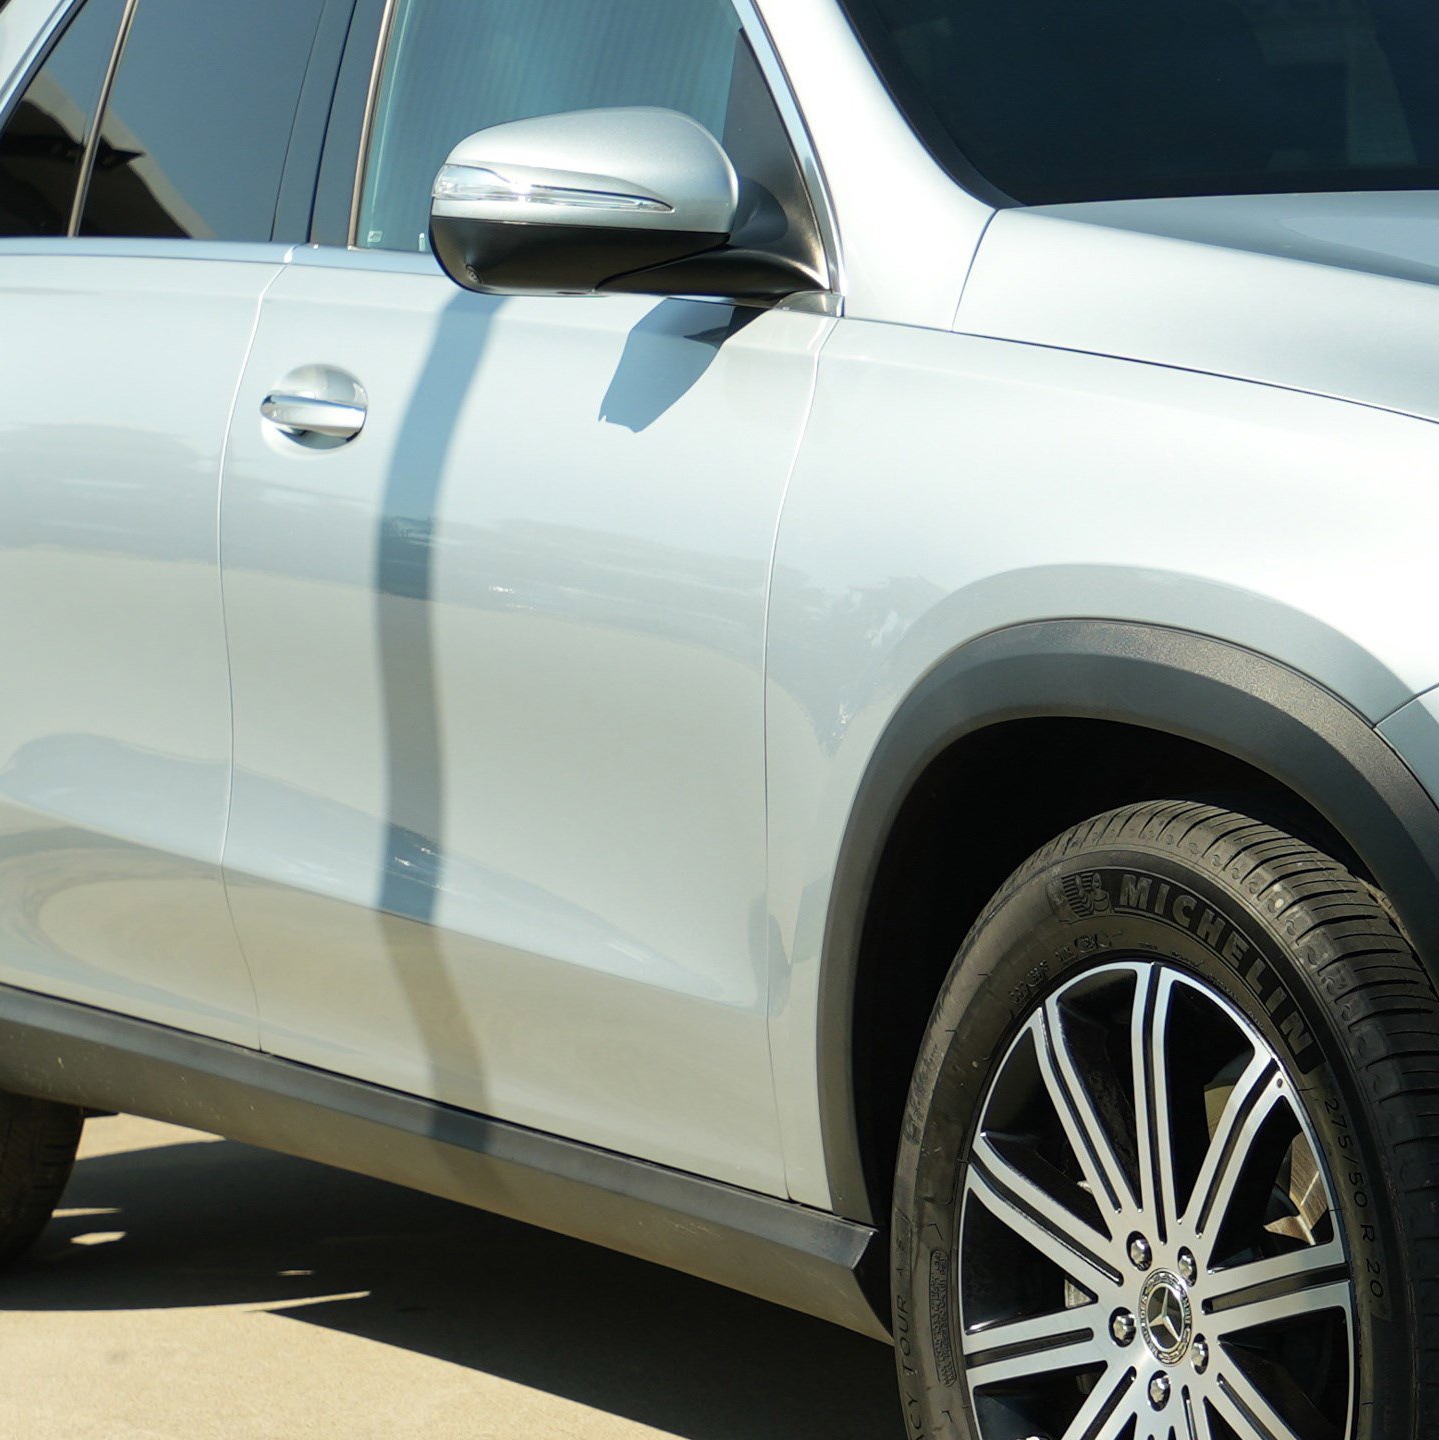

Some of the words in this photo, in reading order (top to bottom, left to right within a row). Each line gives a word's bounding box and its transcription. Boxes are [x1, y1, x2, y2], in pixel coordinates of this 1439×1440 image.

[1119, 873, 1313, 1056] MICHELIN
[1324, 1097, 1369, 1209] 275/50
[1360, 1222, 1376, 1243] R
[1365, 1257, 1385, 1299] 20
[898, 1297, 919, 1375] TOUR
